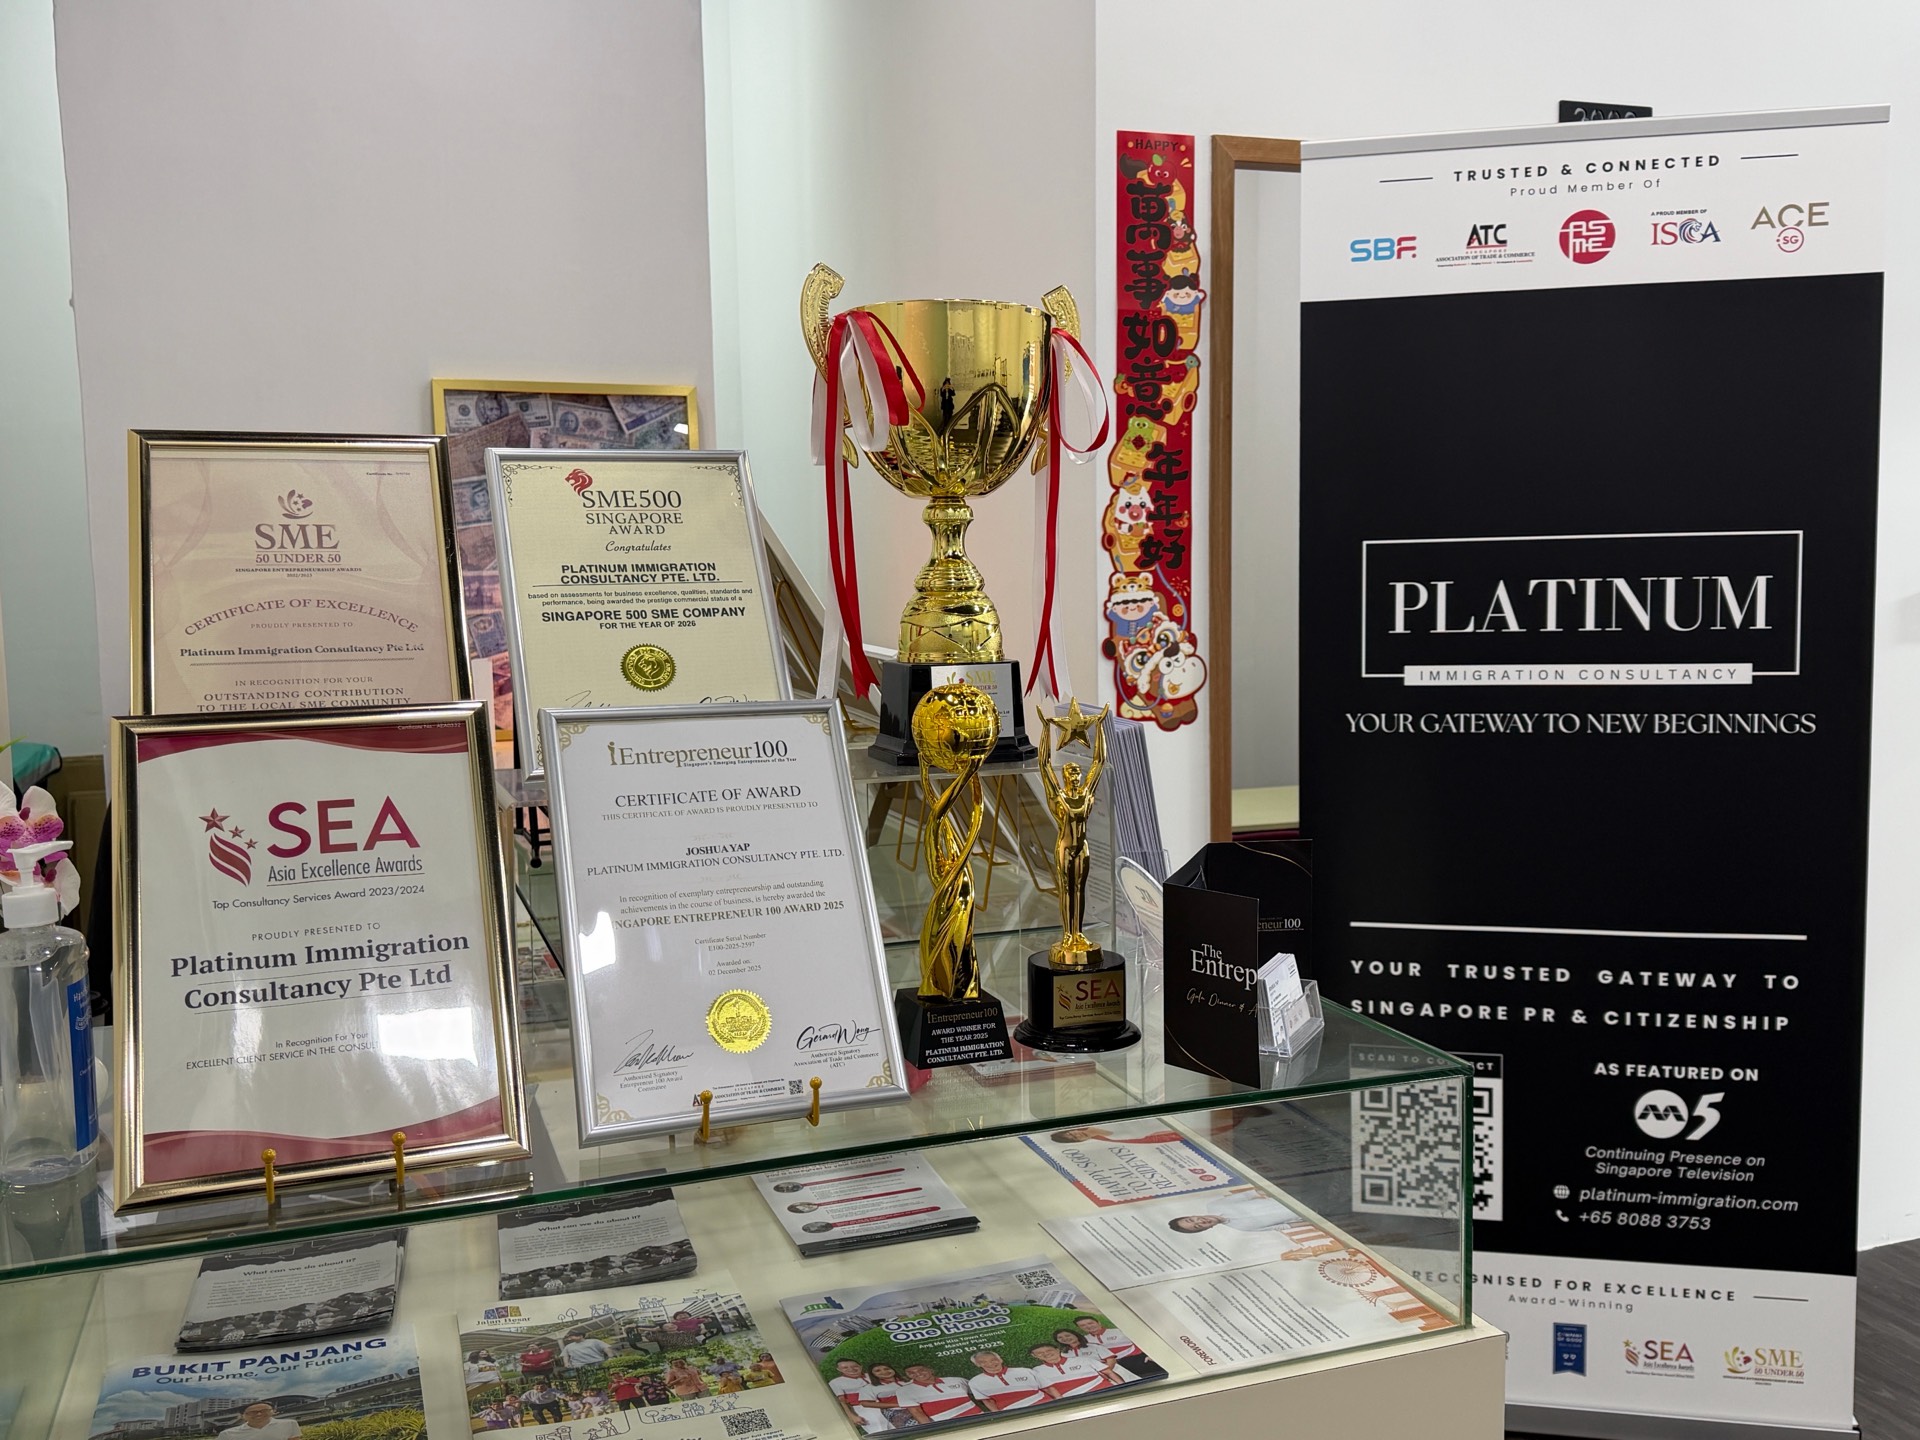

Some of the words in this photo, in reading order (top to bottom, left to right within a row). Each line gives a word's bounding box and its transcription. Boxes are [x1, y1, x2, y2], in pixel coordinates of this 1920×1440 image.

[1135, 139, 1179, 152] HAPPY
[1454, 165, 1548, 182] TRUSTED
[1561, 164, 1572, 175] &
[1586, 155, 1720, 174] CONNECTED
[1510, 185, 1558, 197] Proud
[1568, 181, 1633, 194] Member
[1643, 178, 1661, 189] Of
[1750, 202, 1830, 229] ACE
[1466, 224, 1507, 246] ATC
[1651, 218, 1721, 245] ISCA
[1782, 235, 1799, 244] SG
[1435, 254, 1470, 262] ASSOCIATION
[582, 490, 682, 508] SME500
[586, 512, 683, 524] SINGAPORE
[255, 523, 340, 550] SME
[608, 525, 665, 534] AWARD
[605, 540, 672, 554] Congratulates
[256, 554, 269, 563] 50
[273, 554, 324, 563] UNDER
[328, 554, 341, 563] 50
[562, 564, 628, 573] PLATINUM
[632, 562, 716, 572] IMMIGRATION
[560, 574, 657, 584] CONSULTANCY
[662, 574, 689, 582] PTE.
[693, 572, 720, 582] LTD.
[542, 610, 622, 622] SINGAPORE
[626, 610, 647, 620] 500
[652, 609, 679, 618] SME
[682, 607, 746, 618] COMPANY
[1388, 575, 1773, 633] PLATINUM
[184, 599, 286, 637] CERTIFICATE
[289, 599, 312, 608] OF
[315, 599, 419, 633] EXCELLENCE
[664, 620, 676, 628] OF
[180, 647, 235, 657] Platinum
[238, 646, 312, 658] Immigration
[315, 644, 384, 656] Consultancy
[387, 644, 403, 652] Pte
[406, 643, 424, 652] Ltd
[250, 678, 320, 686] RECOGNITION
[1420, 670, 1565, 681] IMMIGRATION
[1579, 668, 1738, 681] CONSULTANCY
[204, 690, 300, 701] OUTSTANDING
[304, 687, 403, 698] CONTRIBUTION
[1346, 713, 1414, 733] YOUR
[1420, 713, 1539, 733] GATEWAY
[1543, 713, 1580, 733] TO
[1587, 713, 1648, 733] NEW
[1653, 712, 1816, 734] BEGINNINGS
[615, 790, 717, 807] CERTIFICATE
[722, 789, 742, 800] OF
[745, 785, 801, 799] AWARD
[268, 795, 420, 858] SEA
[686, 845, 728, 856] JOSHUA
[729, 843, 750, 853] YAP
[268, 865, 296, 882] Asia
[302, 859, 370, 878] Excellence
[375, 855, 422, 873] Awards
[588, 863, 643, 876] PLATINUM
[646, 858, 719, 871] IMMIGRATION
[722, 852, 798, 865] CONSULTANCY
[800, 850, 821, 859] PTE.
[823, 848, 845, 858] LTD.
[212, 900, 229, 911] Top
[232, 896, 289, 909] Consultancy
[292, 892, 331, 903] Services
[334, 888, 366, 900] Award
[369, 885, 425, 897] 2023/2024
[674, 908, 762, 924] ENTREPRENEUR
[766, 905, 781, 915] 100
[783, 903, 821, 915] AWARD
[824, 901, 844, 911] 2025
[252, 930, 300, 941] PROUDLY
[304, 924, 362, 936] PRESENTED
[367, 922, 381, 930] TO
[171, 951, 296, 978] Platinum
[305, 934, 469, 965] Immigration
[1202, 944, 1222, 959] The
[1191, 949, 1258, 991] Entrep
[1350, 960, 1422, 977] YOUR
[1448, 964, 1571, 982] TRUSTED
[1598, 970, 1738, 989] GATEWAY
[1765, 974, 1799, 990] TO
[184, 975, 352, 1009] Consultancy
[359, 971, 401, 991] Pte
[410, 964, 453, 987] Ltd
[1076, 979, 1120, 1001] SEA
[1351, 1000, 1508, 1020] SINGAPORE
[1525, 1008, 1556, 1023] PR
[1571, 1009, 1588, 1024] &
[1604, 1012, 1789, 1030] CITIZENSHIP
[932, 1028, 955, 1036] AWARD
[956, 1025, 981, 1033] WINNER
[1359, 1053, 1395, 1062] SCAN
[1594, 1063, 1620, 1075] AS
[1626, 1064, 1724, 1080] FEATURED
[1730, 1068, 1758, 1081] ON
[1585, 1146, 1665, 1164] Continuing
[1670, 1150, 1742, 1166] Presence
[1746, 1156, 1765, 1166] on
[1086, 1168, 1131, 1197] HAPPY
[1596, 1162, 1672, 1178] Singapore
[1678, 1166, 1754, 1182] Television
[1580, 1188, 1798, 1212] platinum-immigration.com
[1579, 1212, 1612, 1224] +65
[1617, 1212, 1662, 1227] 8088
[1667, 1216, 1711, 1230] 3753
[1555, 1279, 1592, 1292] FOR
[1604, 1282, 1736, 1302] EXCELLENCE
[1508, 1295, 1634, 1313] Award-Winning
[885, 1319, 930, 1332] One
[892, 1329, 941, 1341] One
[945, 1316, 1009, 1333] Home
[132, 1361, 231, 1378] BUKIT
[239, 1338, 387, 1376] PANJANG
[1180, 1335, 1217, 1366] FOREWORD
[1644, 1340, 1694, 1363] SEA
[1754, 1347, 1803, 1368] SME
[156, 1375, 193, 1384] Our
[199, 1369, 259, 1383] Home,
[264, 1363, 300, 1373] Our
[306, 1353, 362, 1369] Future
